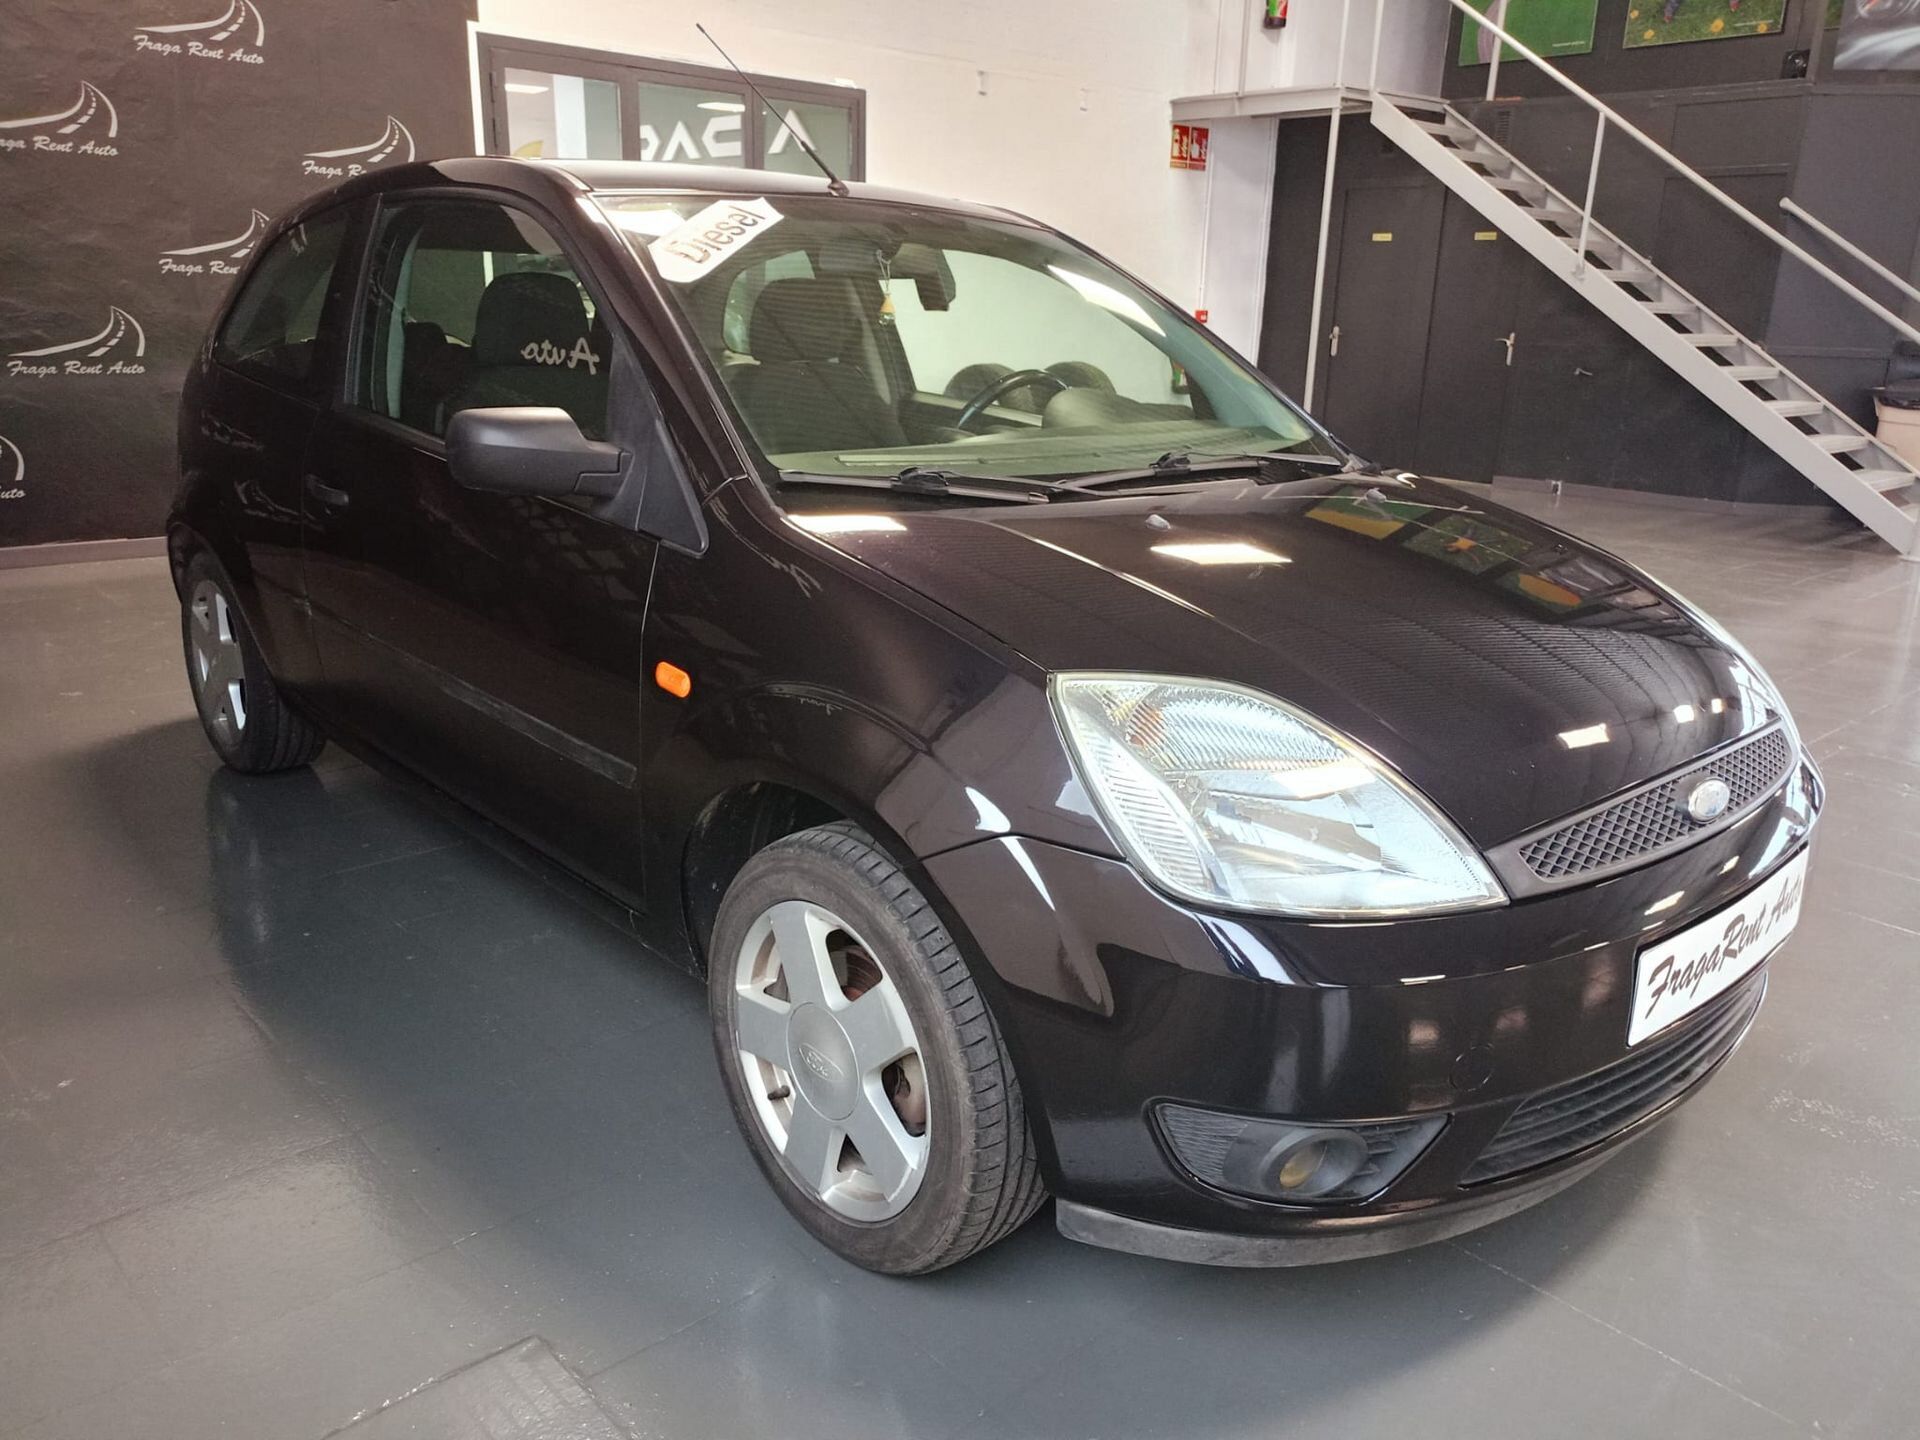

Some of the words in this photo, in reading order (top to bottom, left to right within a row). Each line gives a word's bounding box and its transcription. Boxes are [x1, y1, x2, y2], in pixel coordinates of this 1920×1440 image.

[133, 34, 182, 56] Fraga
[187, 41, 224, 59] Rent
[228, 48, 264, 64] Auto
[32, 135, 73, 152] Rent
[77, 140, 119, 156] Auto
[302, 160, 343, 179] Fraga
[665, 204, 766, 264] Diesel
[158, 258, 204, 276] Fraga
[6, 360, 58, 378] Fraga
[64, 360, 103, 375] Rent
[106, 360, 146, 375] Auto
[0, 487, 26, 499] uto
[1645, 954, 1721, 1019] Fraga
[1718, 903, 1767, 972] Rent
